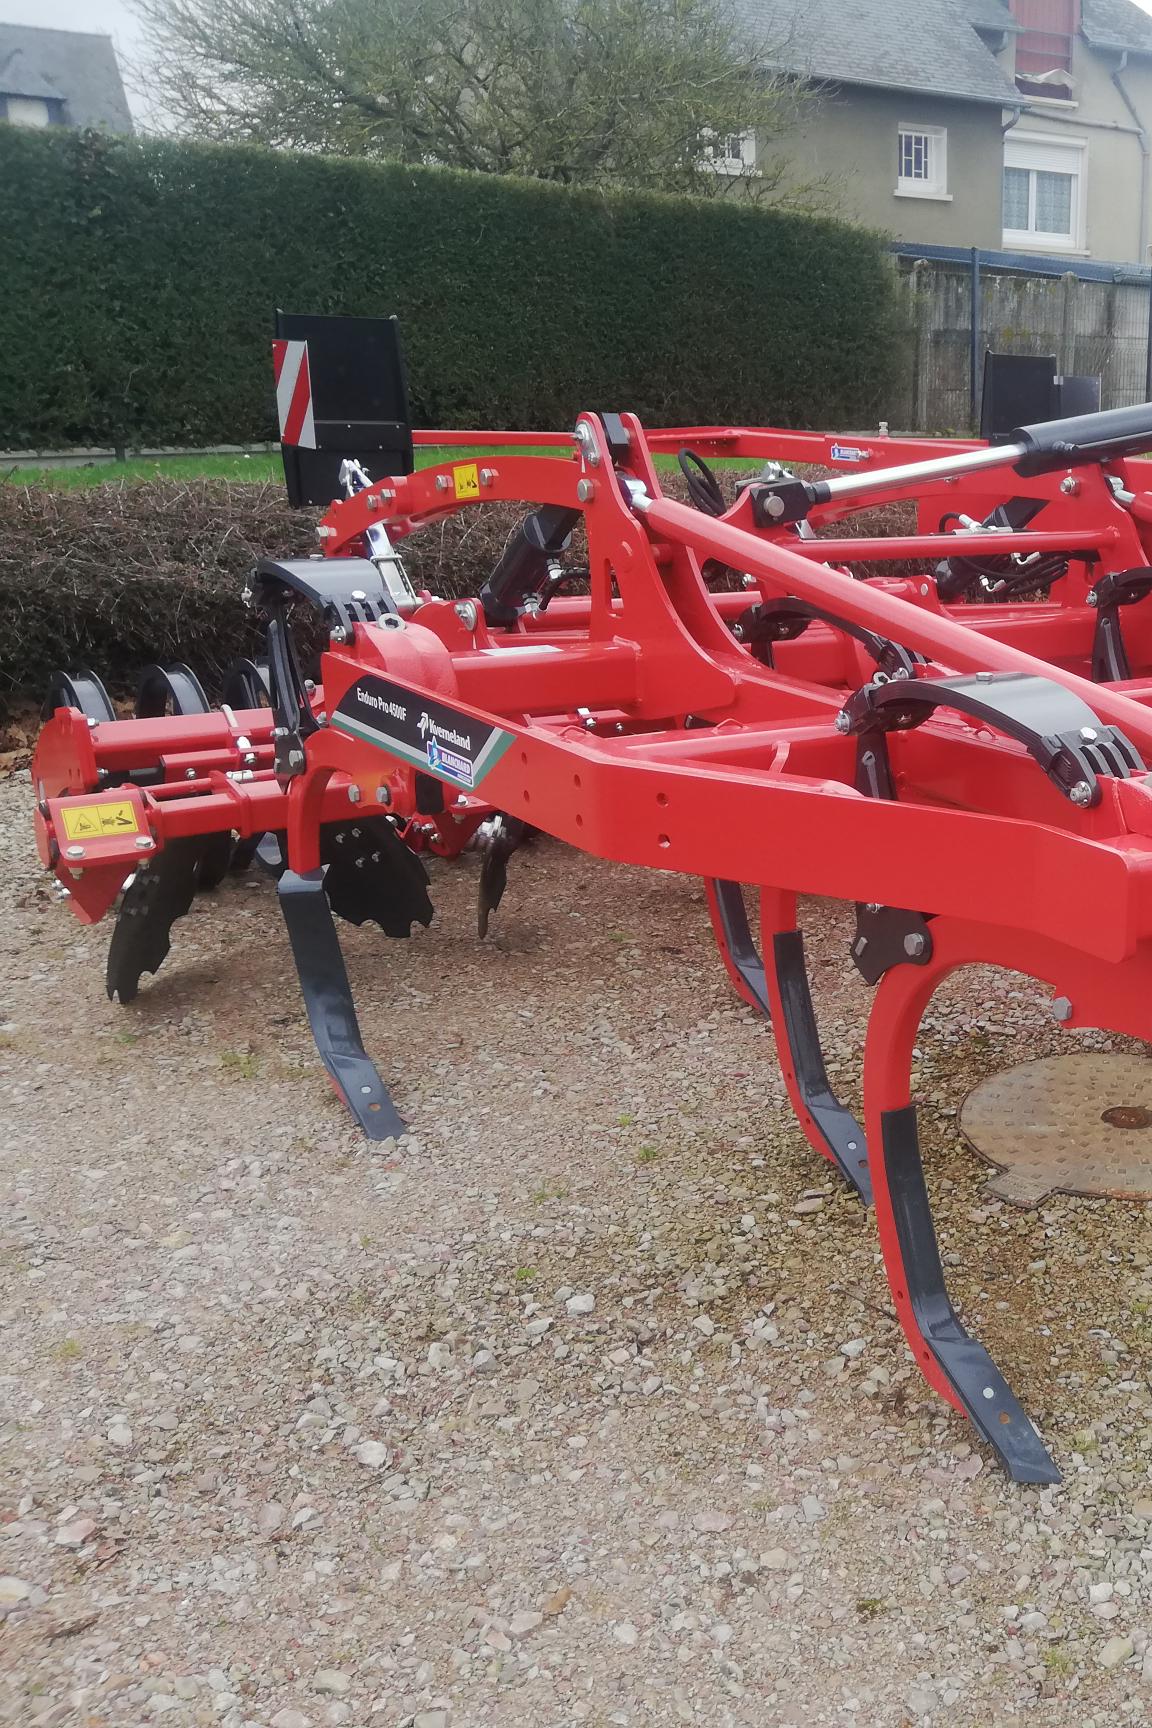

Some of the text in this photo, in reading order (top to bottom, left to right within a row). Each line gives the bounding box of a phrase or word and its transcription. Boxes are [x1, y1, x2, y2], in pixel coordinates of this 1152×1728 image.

[357, 688, 407, 721] Enduro Pro 4500F
[428, 717, 472, 751] Kverneland
[441, 751, 472, 774] BLANCHARD
